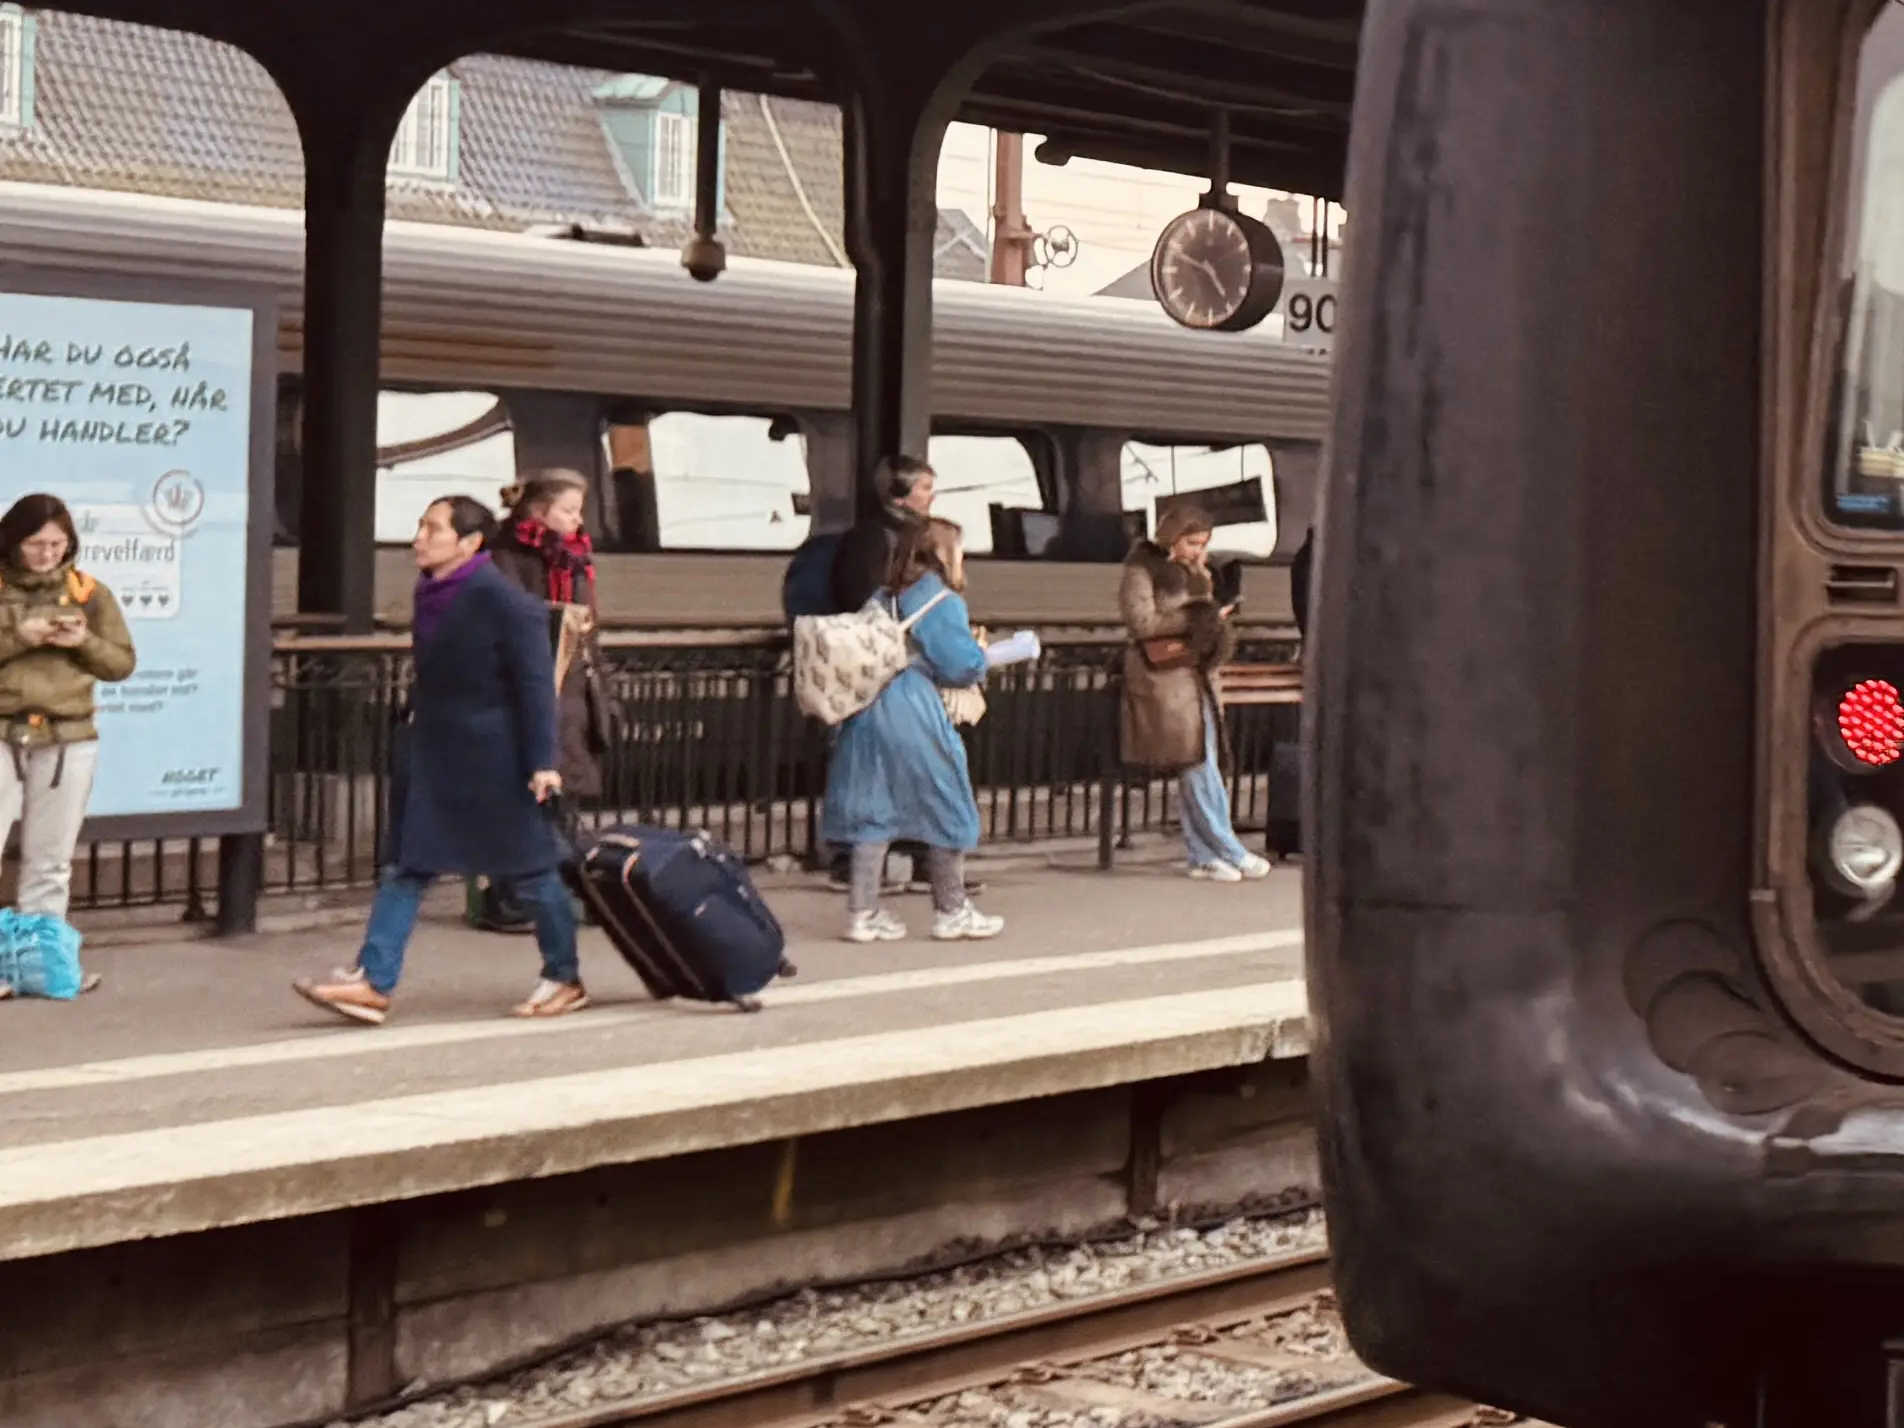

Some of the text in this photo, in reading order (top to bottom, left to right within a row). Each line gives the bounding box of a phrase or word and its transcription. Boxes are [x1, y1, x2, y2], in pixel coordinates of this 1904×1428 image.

[0, 334, 190, 371] HAR DU OGSÅ
[89, 381, 157, 413] MED,
[170, 380, 228, 412] NÅR
[39, 418, 191, 447] HANDLER?
[83, 537, 175, 562] revelfærd
